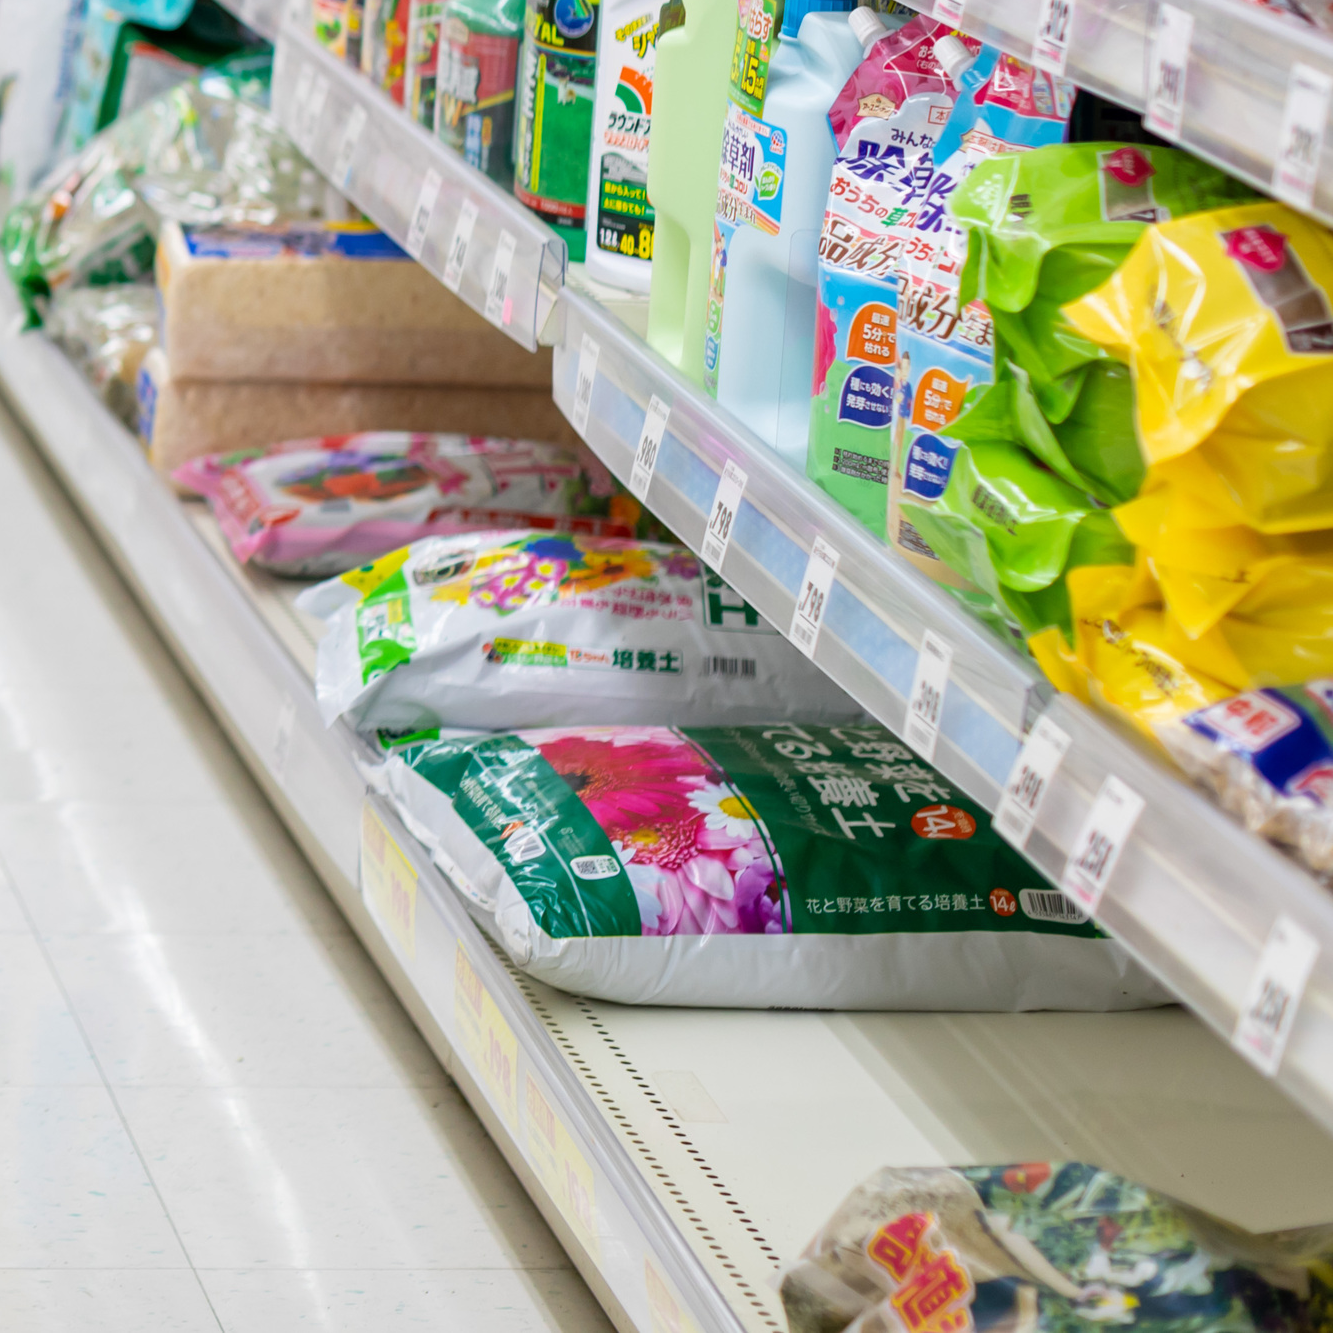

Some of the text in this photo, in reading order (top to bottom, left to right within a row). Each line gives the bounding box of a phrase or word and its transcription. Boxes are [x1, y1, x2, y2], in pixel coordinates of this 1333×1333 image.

[864, 340, 891, 359] 枯れる
[639, 434, 658, 464] 980
[714, 500, 734, 541] 798
[801, 580, 825, 624] 798
[612, 648, 681, 673] 培養土
[805, 893, 987, 915] 花と野菜を育てる培養土
